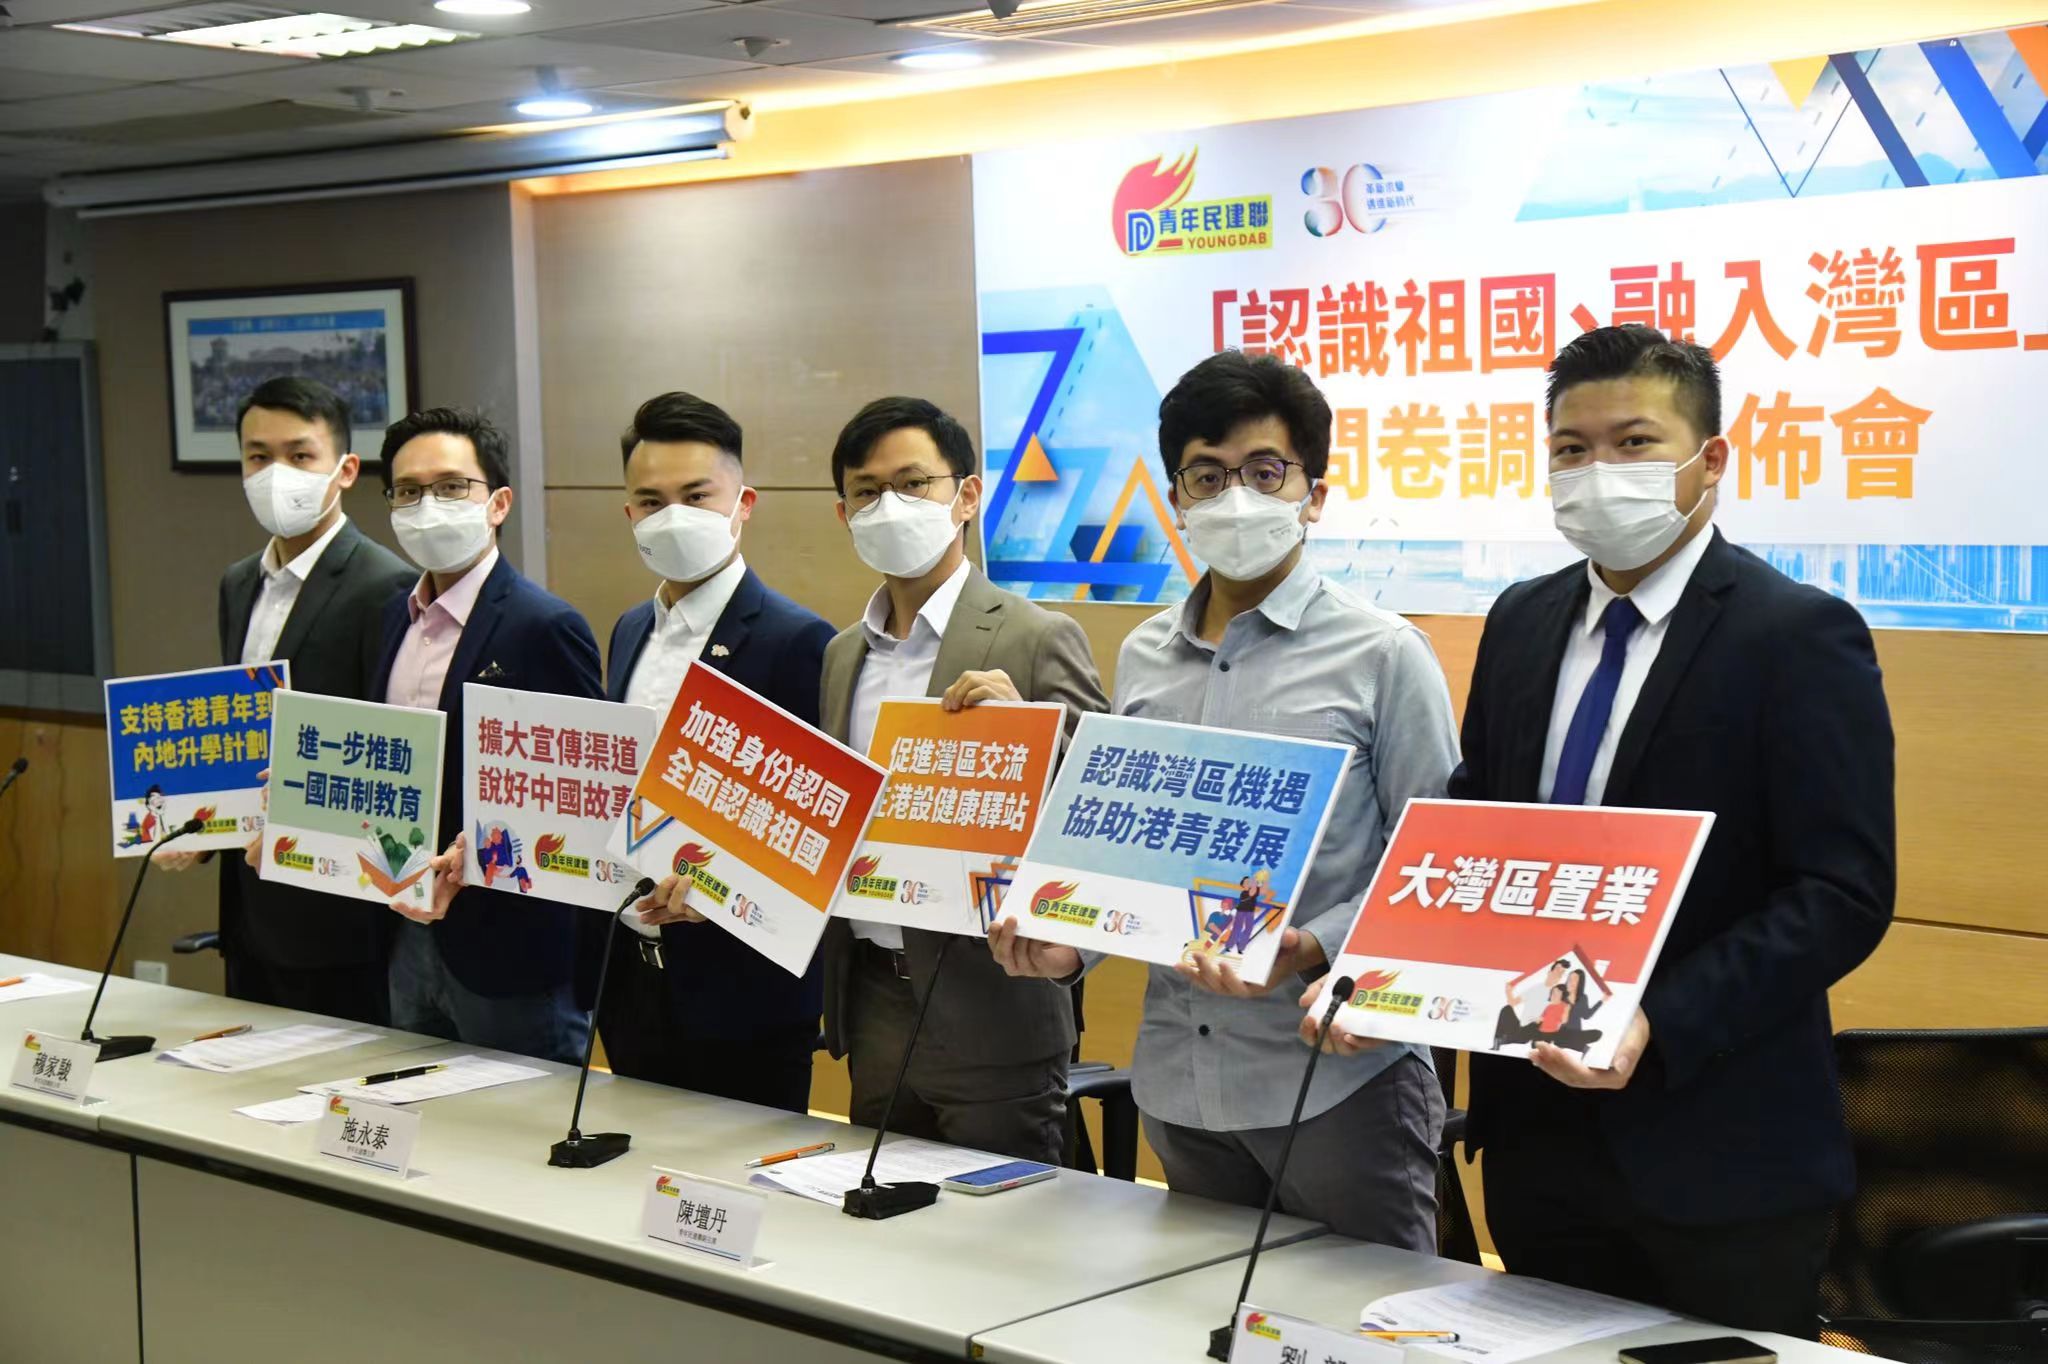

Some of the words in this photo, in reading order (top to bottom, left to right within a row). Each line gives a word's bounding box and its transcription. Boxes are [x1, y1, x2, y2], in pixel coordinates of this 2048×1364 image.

[1158, 200, 1269, 235] 青年民建聯
[1187, 231, 1268, 249] YOUNGDAB
[297, 723, 413, 776] 進一步推動
[478, 716, 639, 776] 擴大宣傳渠道
[680, 700, 851, 828] 加強身份認同
[890, 736, 1029, 782] 促進灣區交流
[283, 770, 422, 823] 一國兩制教育
[1080, 744, 1311, 816] 認識灣區機遇
[661, 747, 831, 876] 全面認識祖國
[1061, 794, 1291, 870] 協助港青發展
[1388, 852, 1659, 926] 大灣區置業
[340, 1116, 391, 1150] 施永泰
[676, 1199, 728, 1234] 陳壇丹
